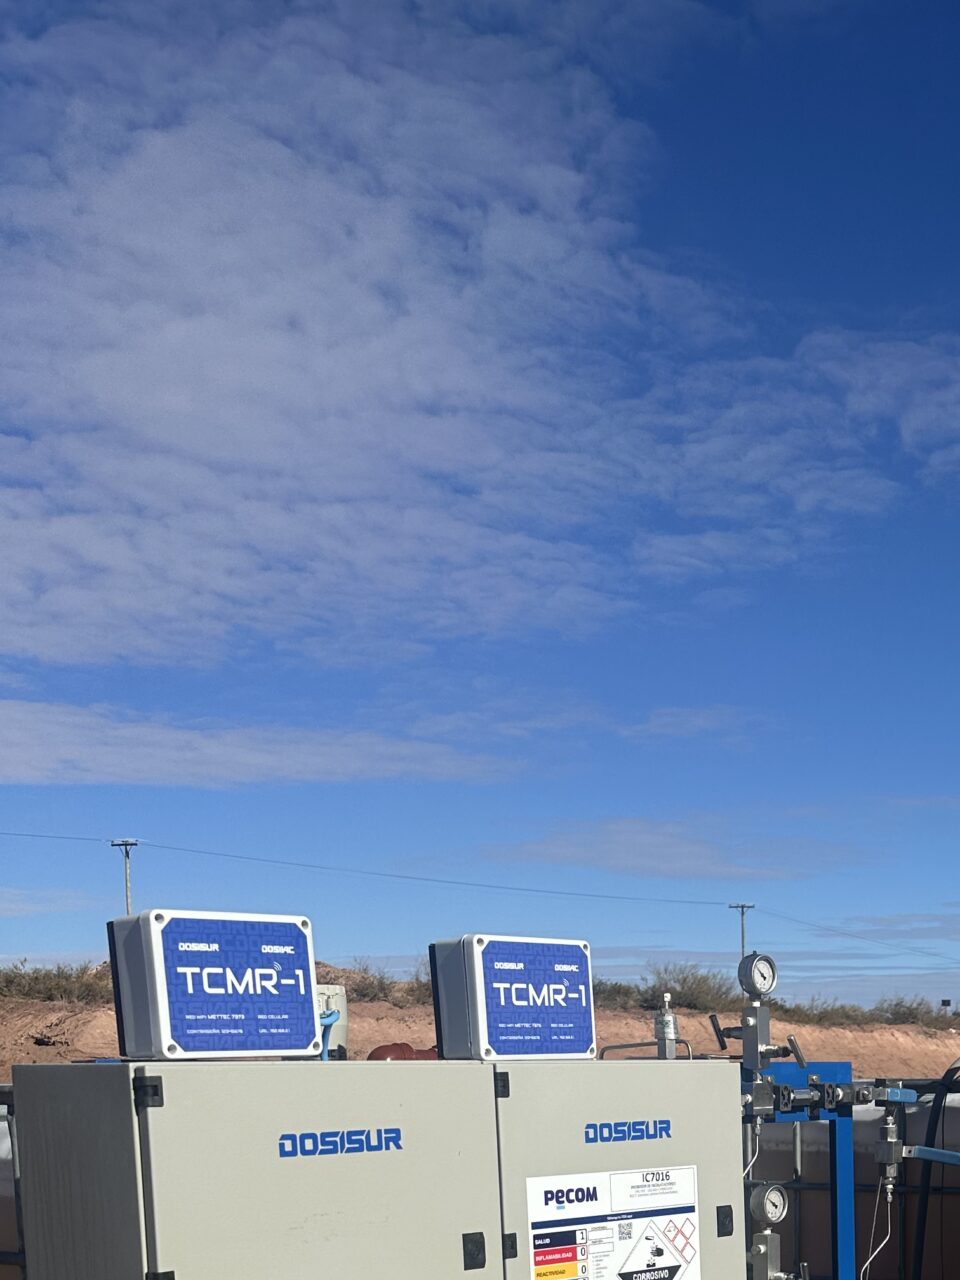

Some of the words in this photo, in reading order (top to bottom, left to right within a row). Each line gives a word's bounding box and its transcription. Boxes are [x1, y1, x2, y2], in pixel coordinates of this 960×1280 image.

[178, 942, 219, 952] DOSISUR
[177, 967, 305, 995] TCMR-1
[493, 982, 586, 1007] TCMR-1
[584, 1119, 672, 1144] DOSISUR
[278, 1128, 403, 1158] DOSISUR
[642, 1171, 671, 1183] IC7016
[580, 1231, 585, 1240] 1
[535, 1252, 573, 1262] INFLAMABILIDAD
[580, 1247, 586, 1256] 0
[581, 1264, 587, 1274] 0
